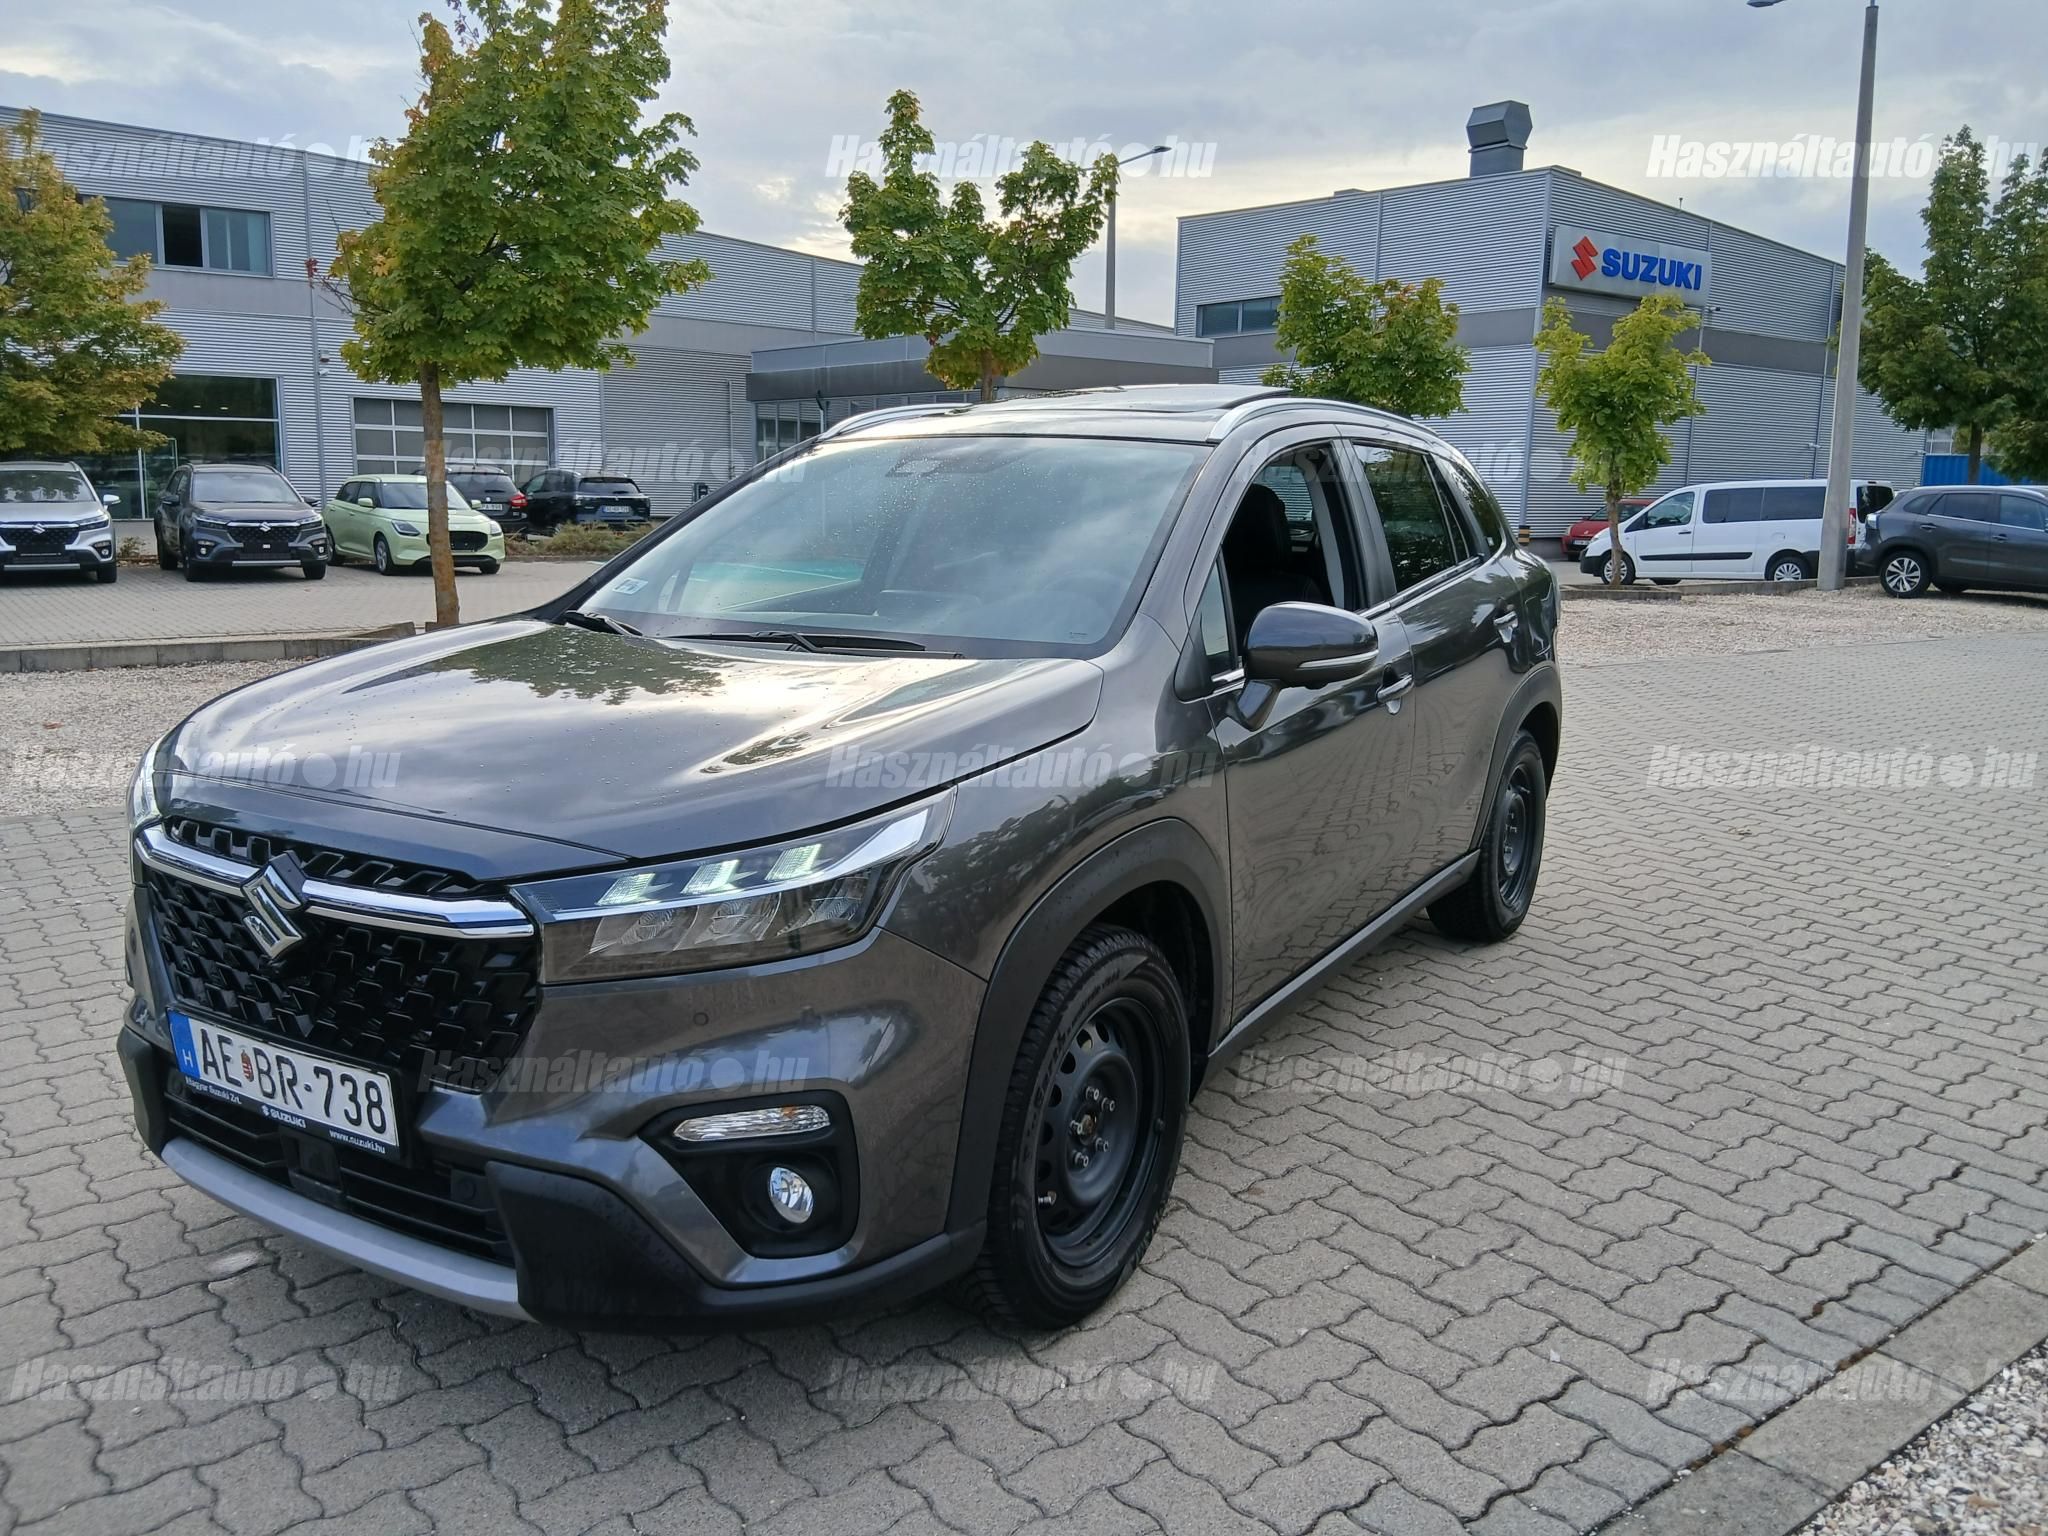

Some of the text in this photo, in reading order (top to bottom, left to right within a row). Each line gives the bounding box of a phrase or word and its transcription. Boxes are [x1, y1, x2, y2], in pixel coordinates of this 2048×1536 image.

[1601, 248, 1703, 291] SUZUKI
[182, 1049, 194, 1068] H
[270, 1108, 307, 1129] SUZUKI
[329, 1129, 386, 1154] www.suzuki.hu
